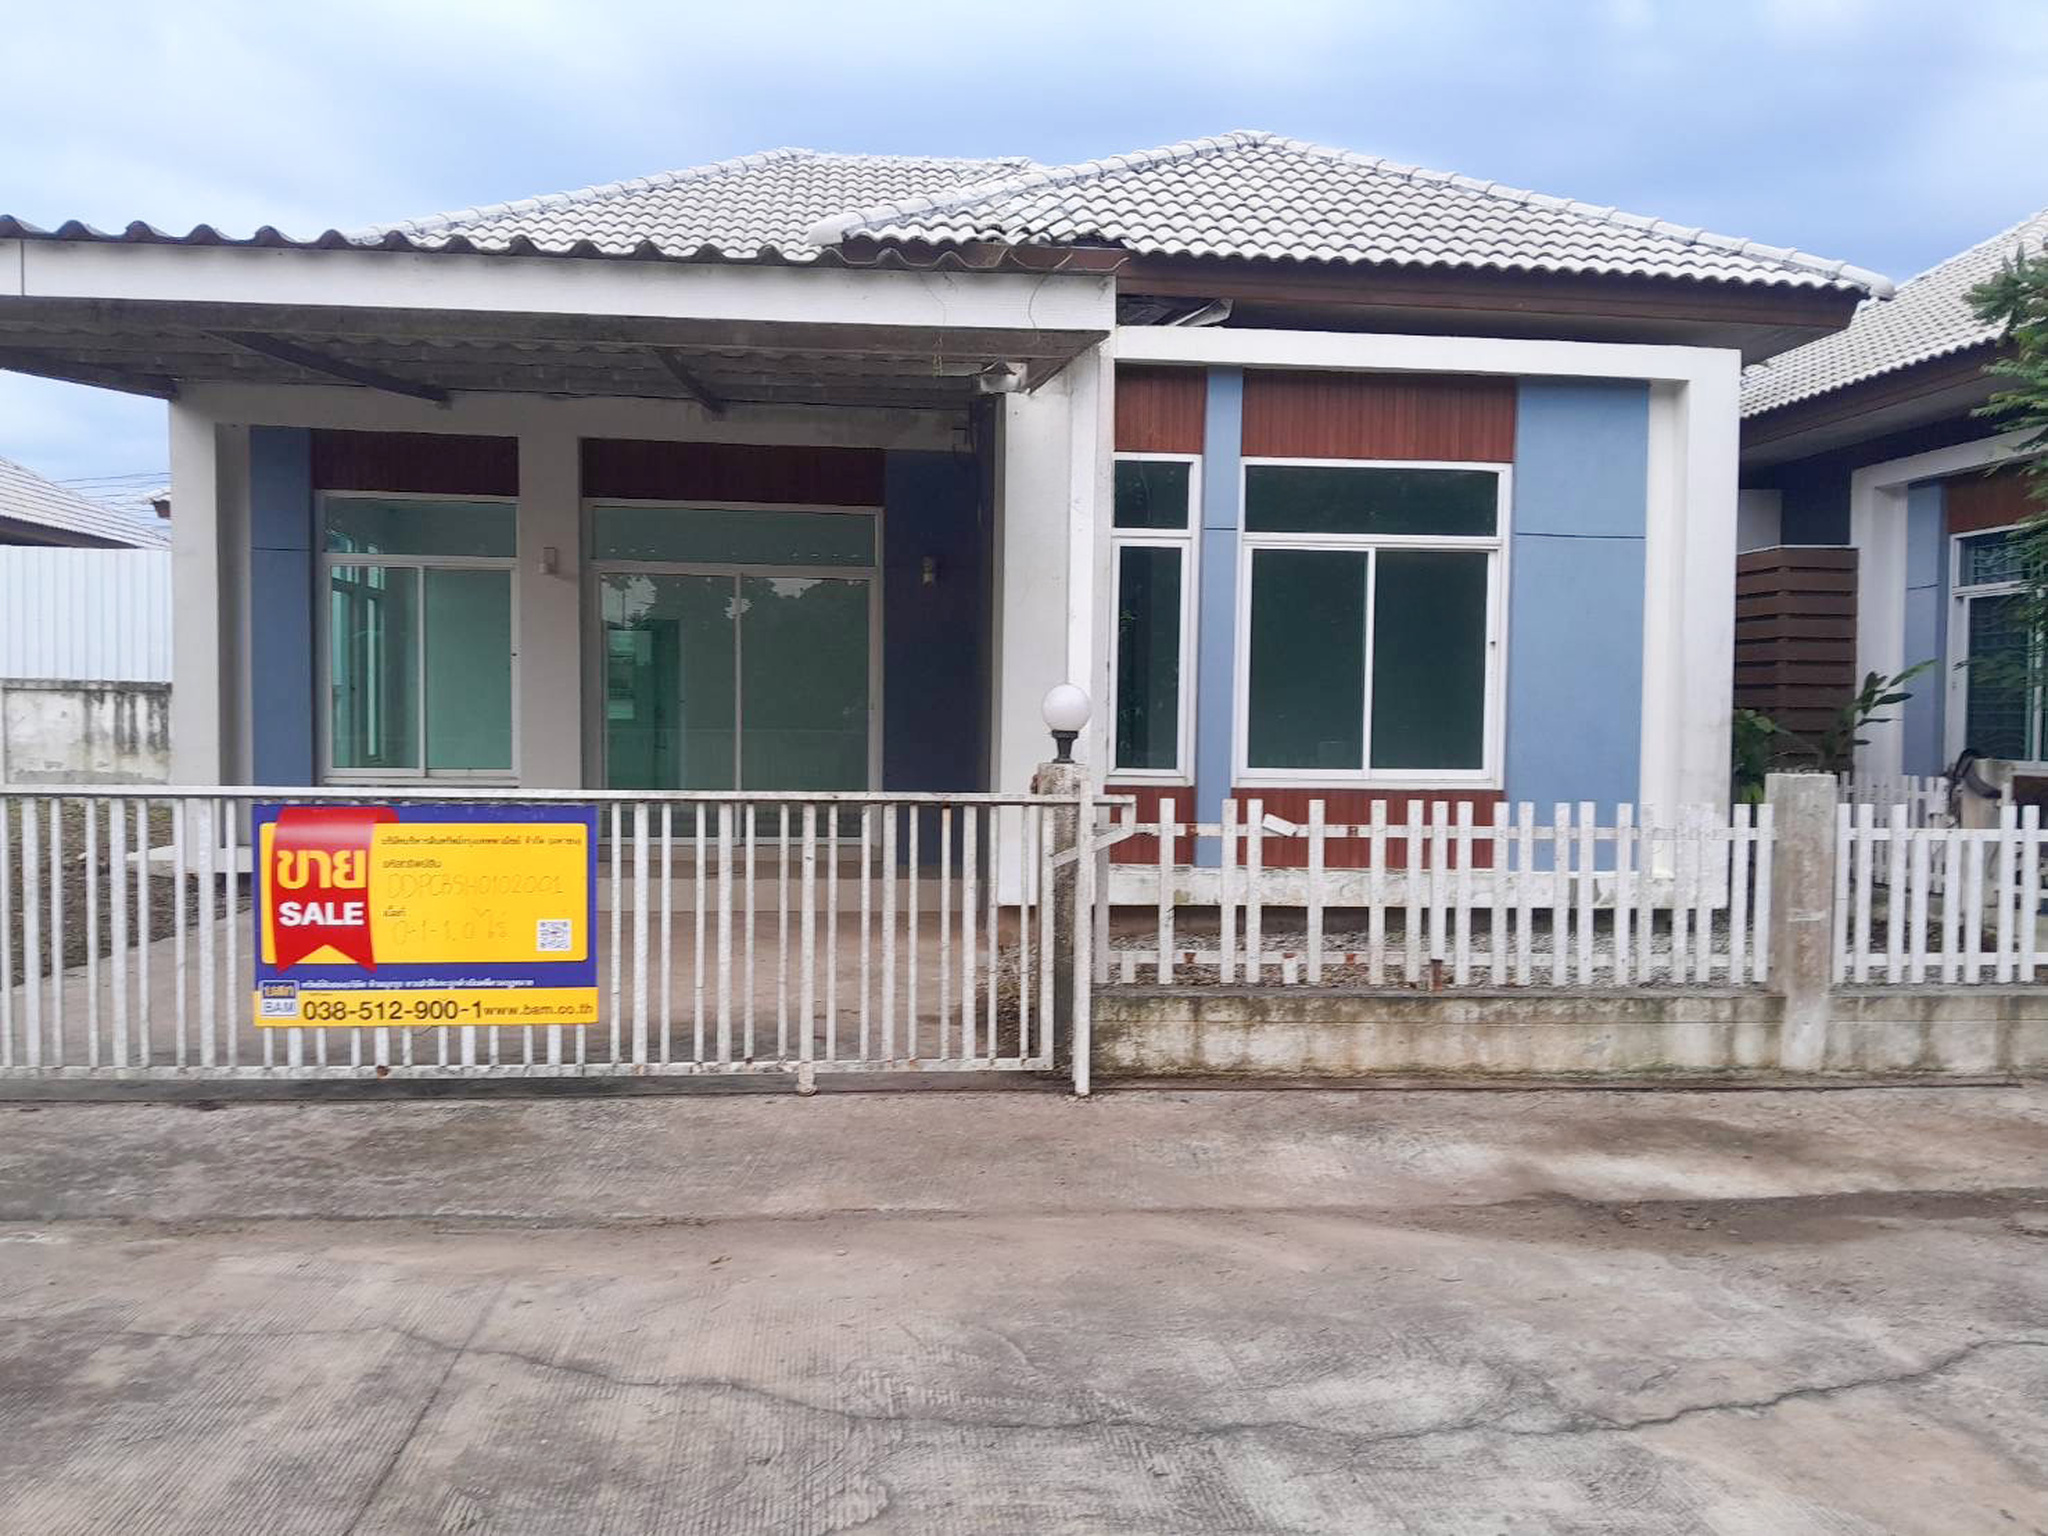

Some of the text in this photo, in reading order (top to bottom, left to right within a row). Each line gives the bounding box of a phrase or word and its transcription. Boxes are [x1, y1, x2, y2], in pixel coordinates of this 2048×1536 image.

[277, 850, 366, 888] ขาย
[279, 901, 364, 926] SALE
[264, 1000, 296, 1014] BAM
[303, 1000, 594, 1020] 038-512-900-1 www.bam.co.th
